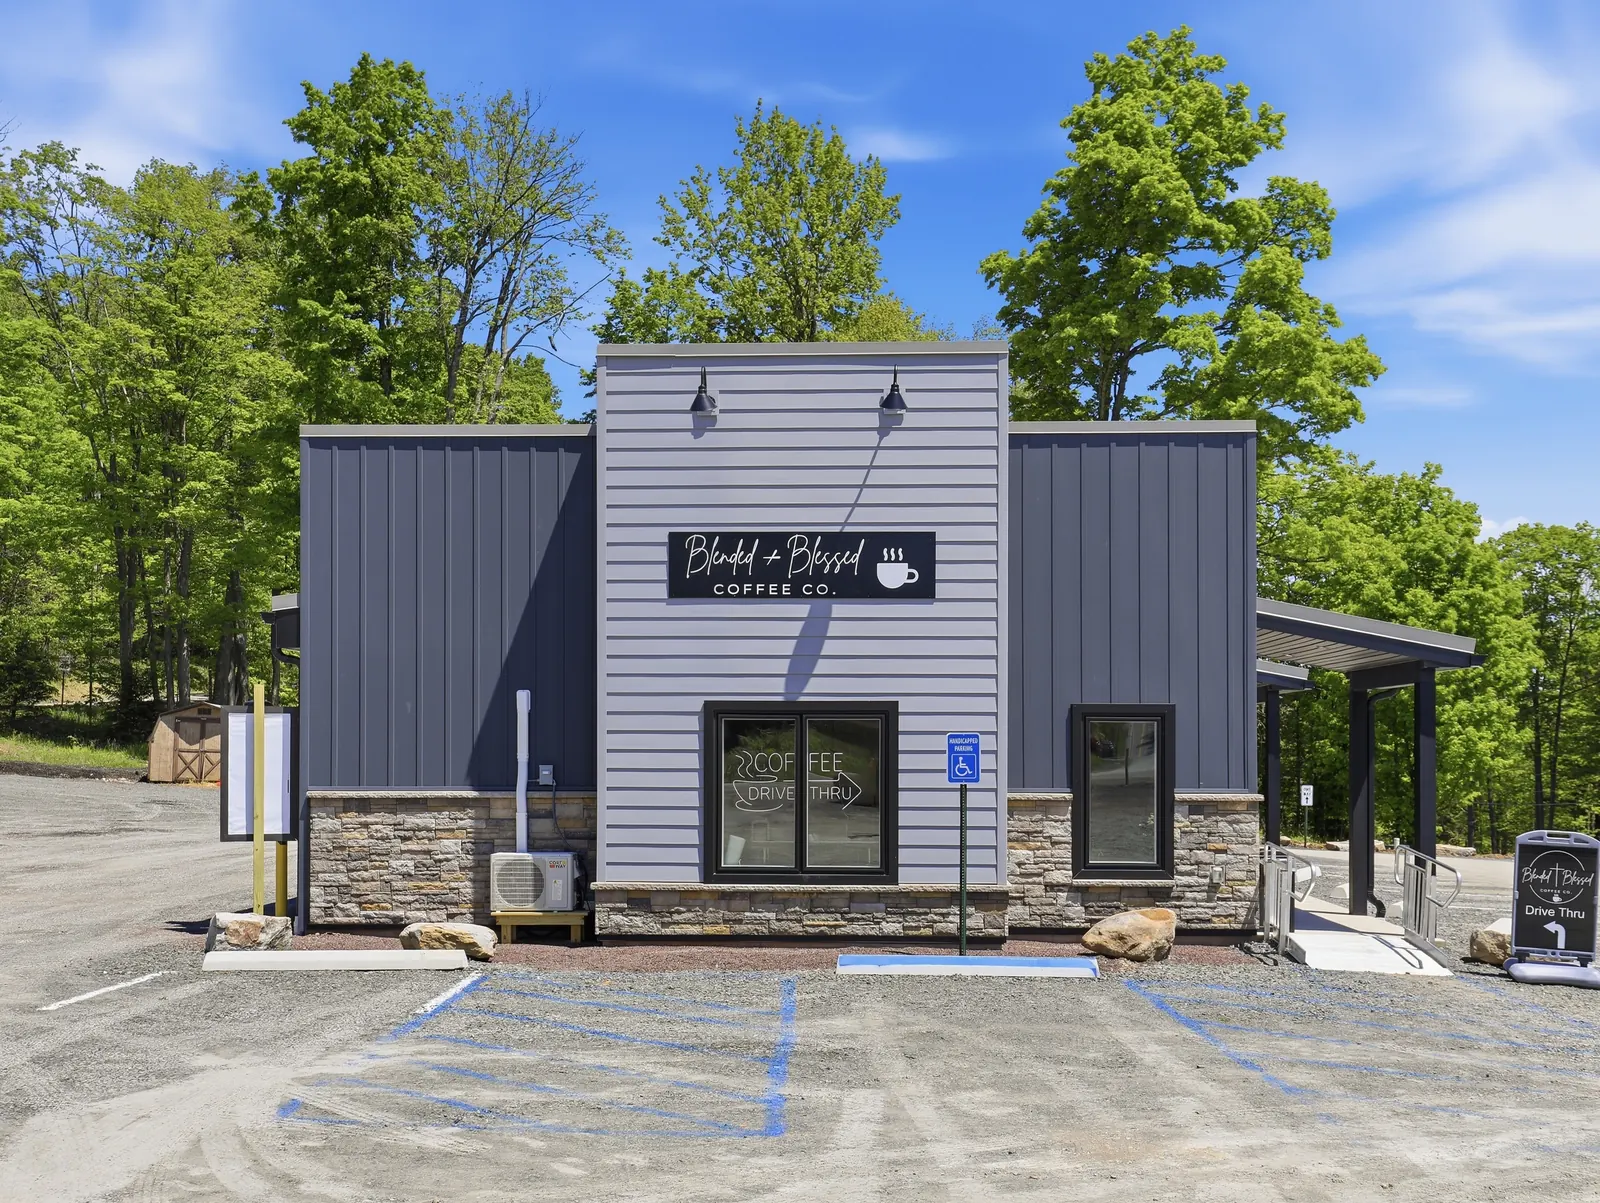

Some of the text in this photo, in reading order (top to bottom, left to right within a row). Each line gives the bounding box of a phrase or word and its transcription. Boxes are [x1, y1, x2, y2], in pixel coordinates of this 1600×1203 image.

[685, 534, 759, 579] Blended
[787, 534, 865, 579] Blessed
[713, 583, 837, 595] COFFEE CO.
[754, 752, 844, 773] COFFEE
[748, 786, 852, 801] DRIVE THRU
[1521, 866, 1595, 887] Blended Blessed
[1525, 905, 1585, 919] Drive Thru
